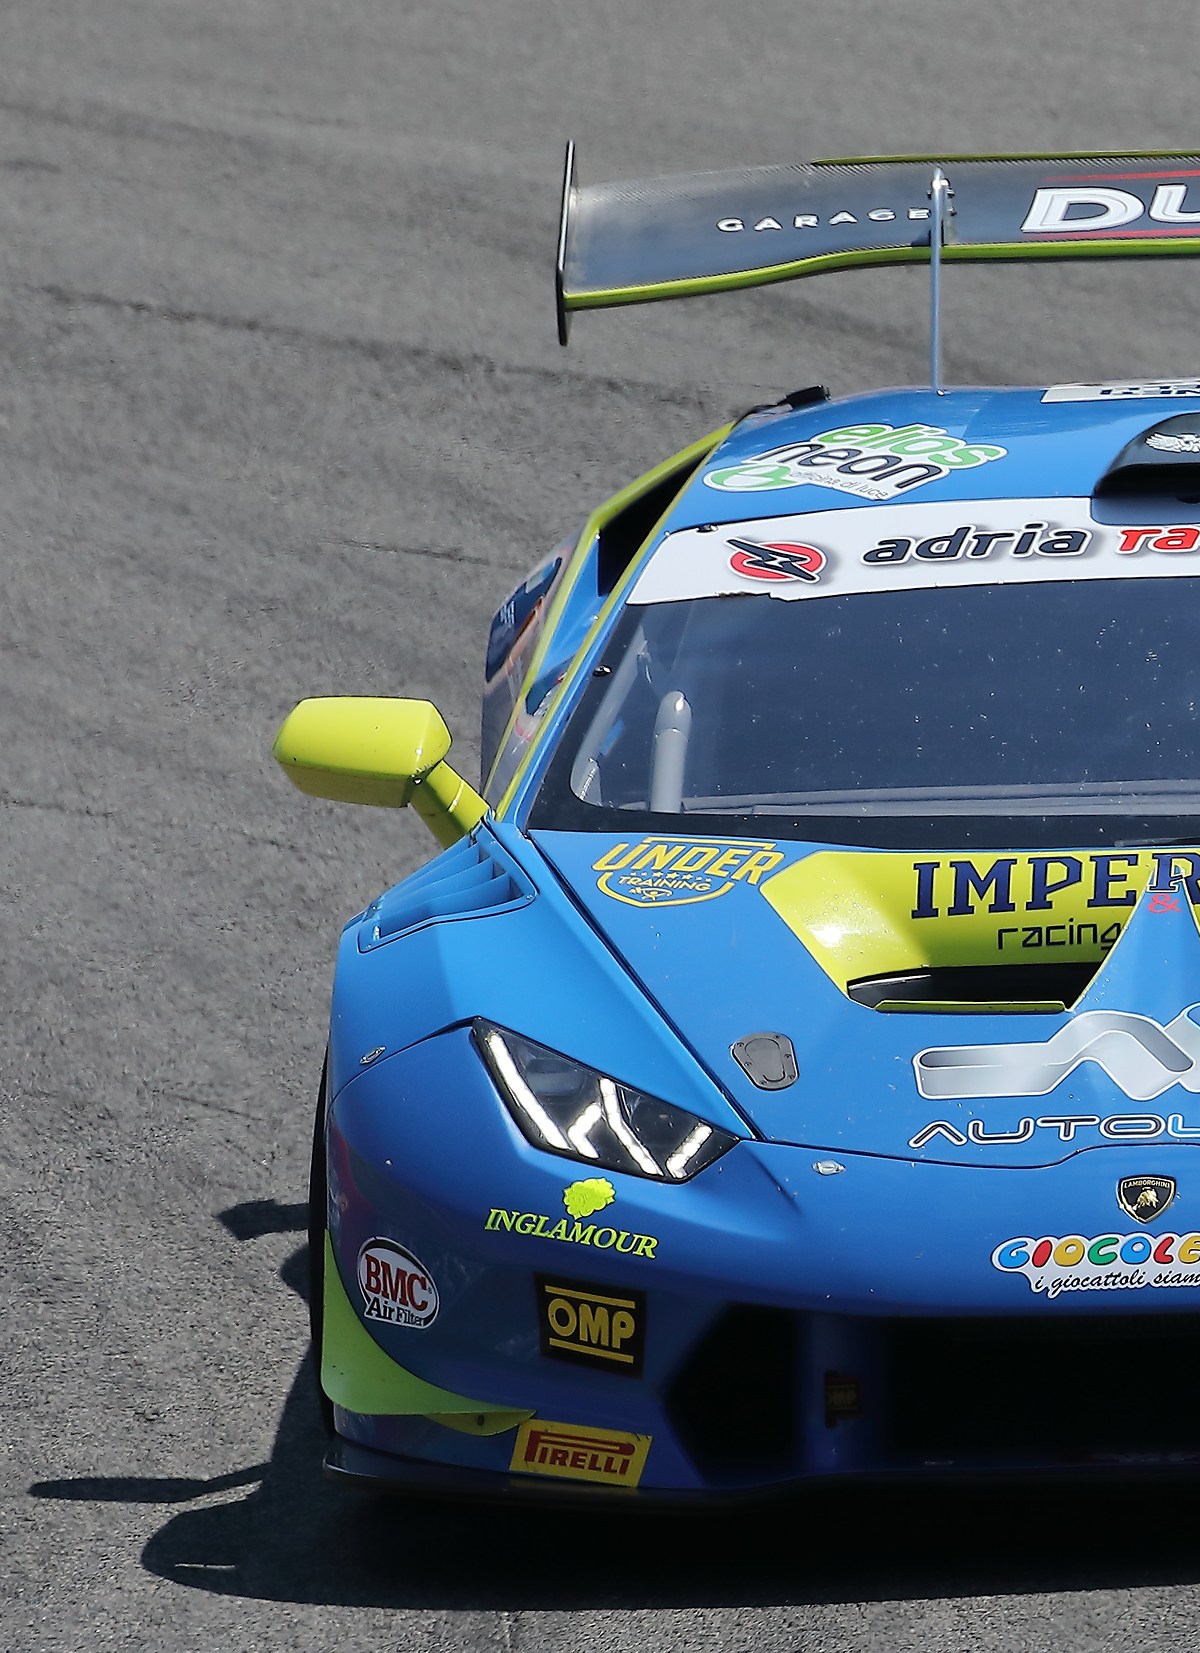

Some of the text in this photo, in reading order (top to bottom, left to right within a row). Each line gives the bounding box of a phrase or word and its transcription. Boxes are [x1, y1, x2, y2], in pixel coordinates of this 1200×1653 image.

[716, 207, 931, 232] GARAGE
[749, 443, 943, 489] neon
[817, 424, 1001, 467] elios
[864, 522, 1091, 562] adria
[592, 841, 785, 886] UNDER
[617, 874, 712, 893] TRAINING
[1147, 893, 1182, 914] &
[1124, 1179, 1170, 1189] LAMBORGHINI
[484, 1208, 659, 1260] INGLAMOUR
[365, 1253, 429, 1312] BMC
[1034, 1275, 1046, 1290] i
[1050, 1269, 1146, 1298] giocattoli
[366, 1297, 395, 1320] Air
[548, 1298, 636, 1350] OMP
[523, 1429, 637, 1476] PIRELLI
